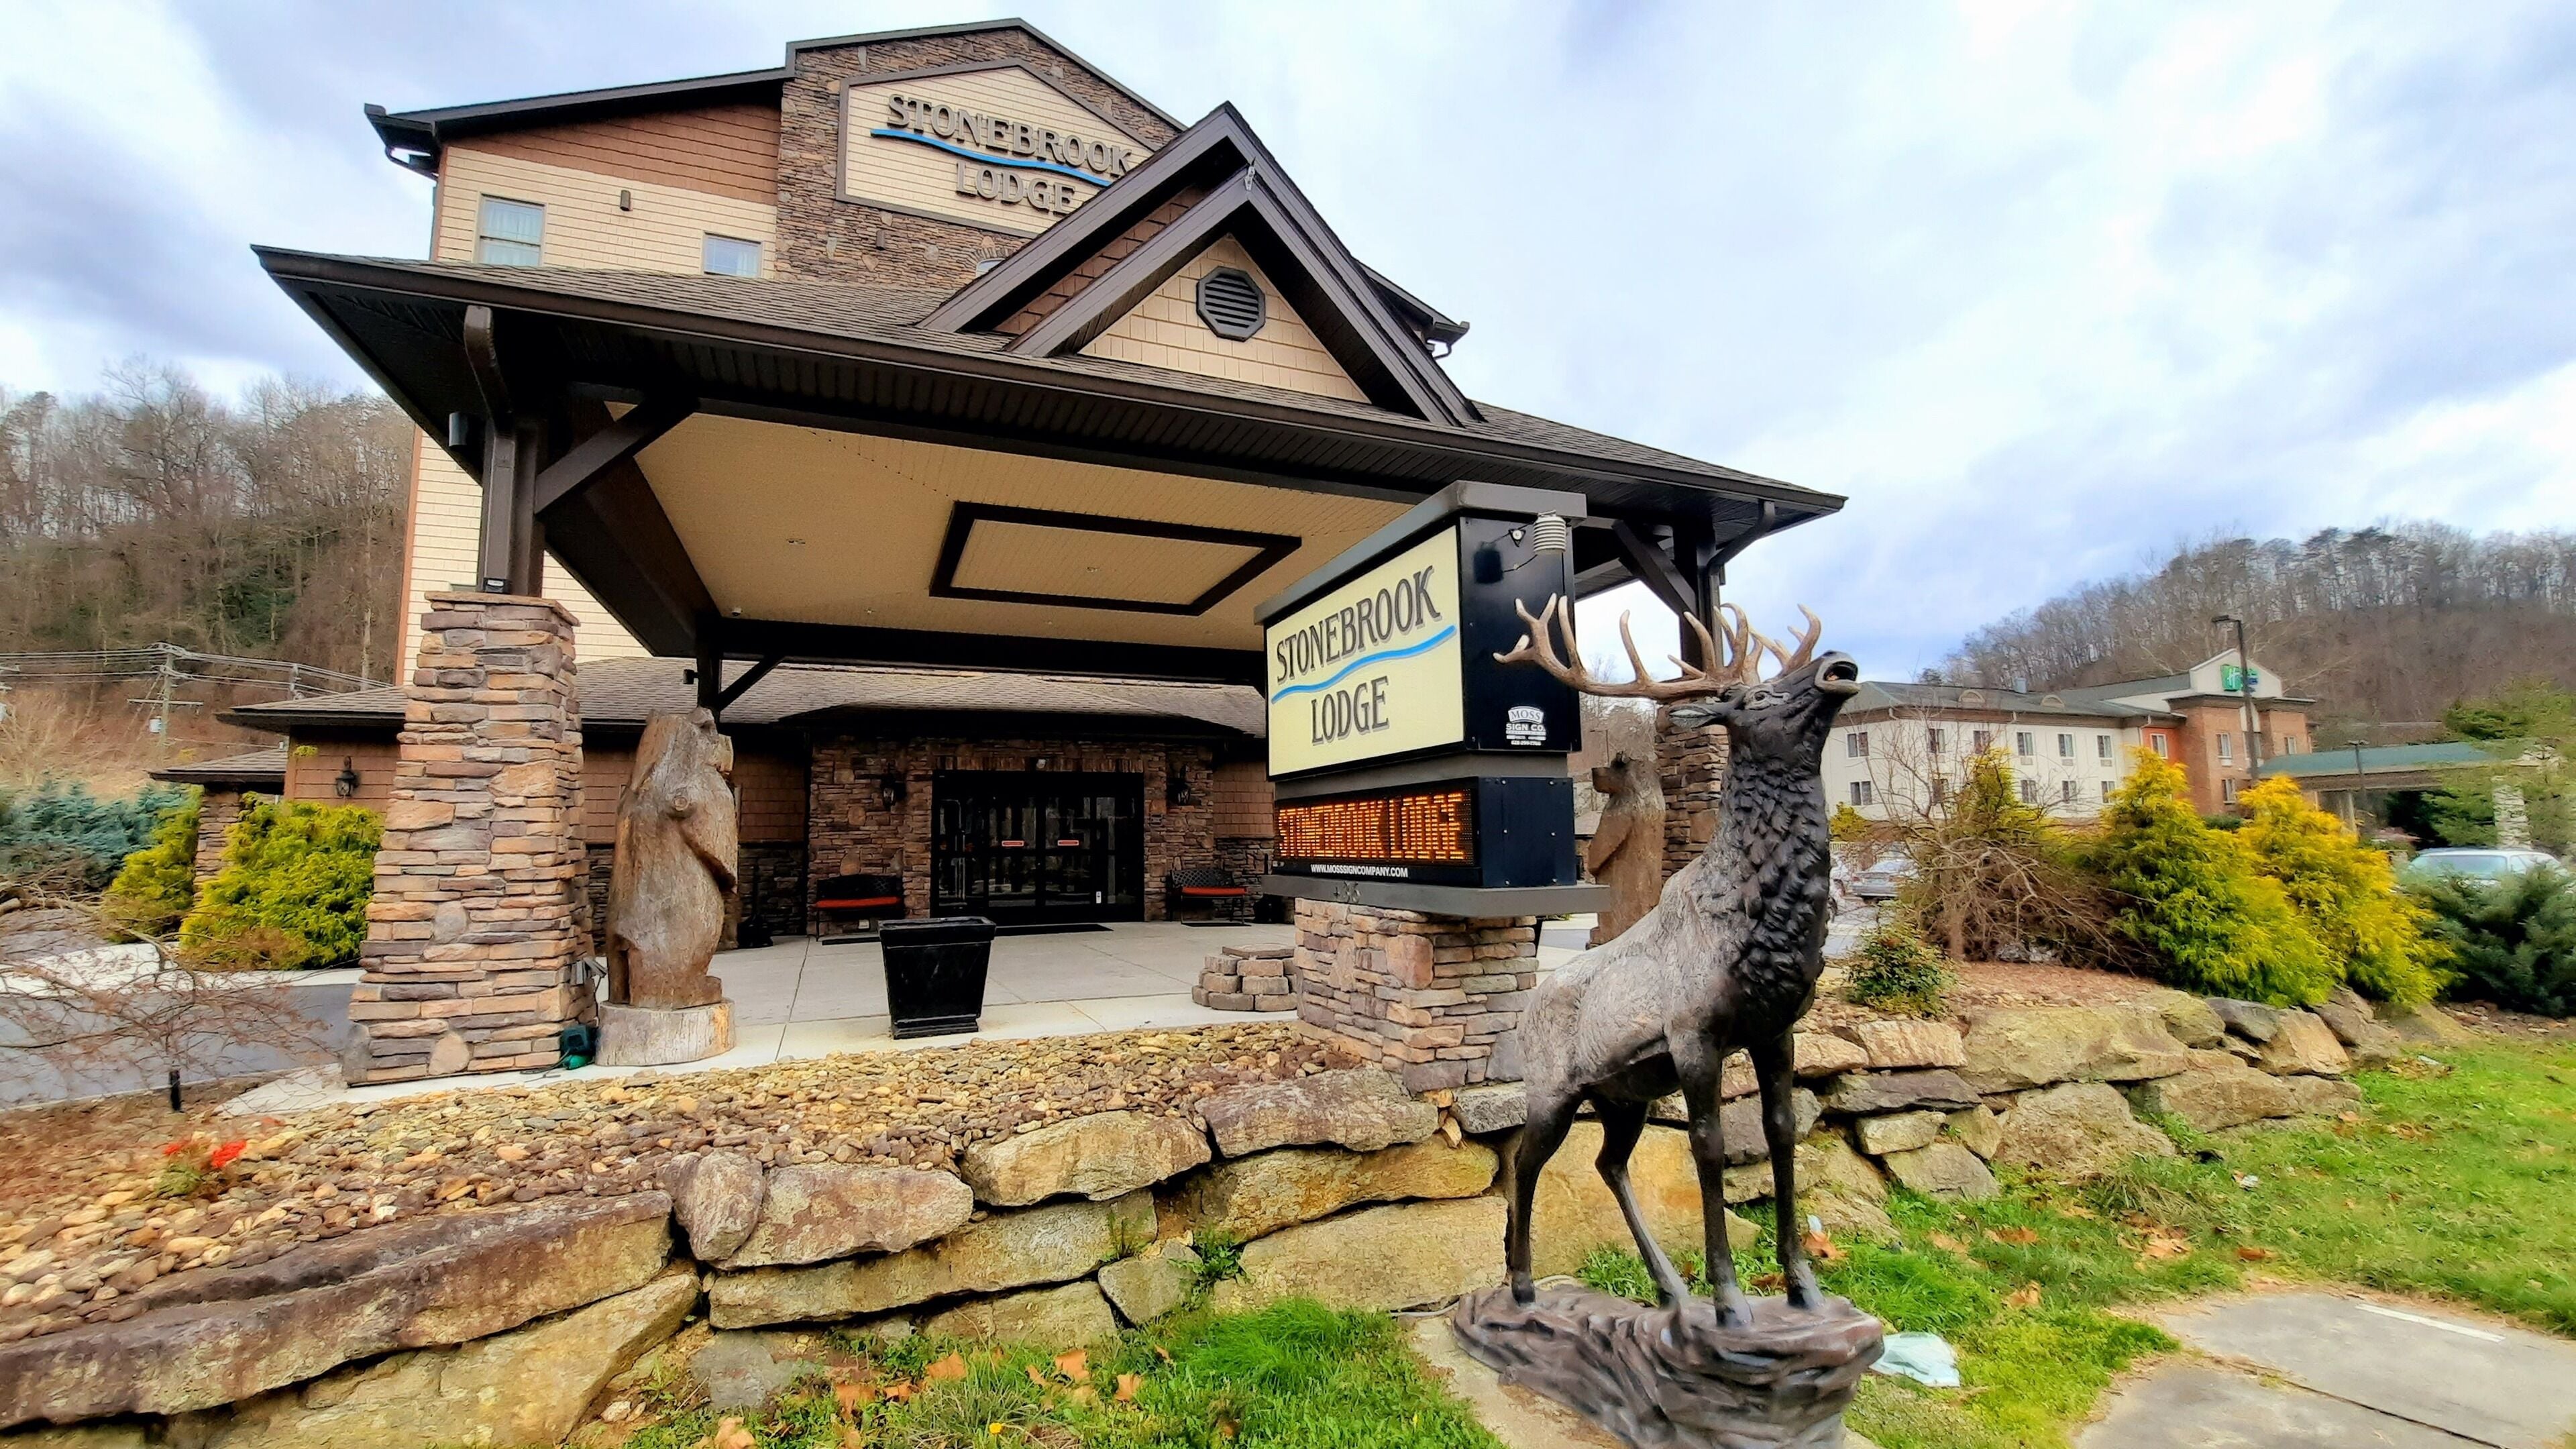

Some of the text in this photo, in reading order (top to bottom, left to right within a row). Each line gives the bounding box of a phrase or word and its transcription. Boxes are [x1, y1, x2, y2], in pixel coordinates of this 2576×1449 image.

[886, 93, 1133, 177] STONEBROOK
[955, 162, 1076, 216] LODGE
[1276, 565, 1442, 685] STONEBROOK
[1311, 675, 1389, 746] LODGE
[1510, 710, 1541, 720] MOSS
[1277, 792, 1465, 860] STONEBROOK LODGE
[1310, 863, 1409, 878] WWW.MOSSSIGNCOMPANY.COM
